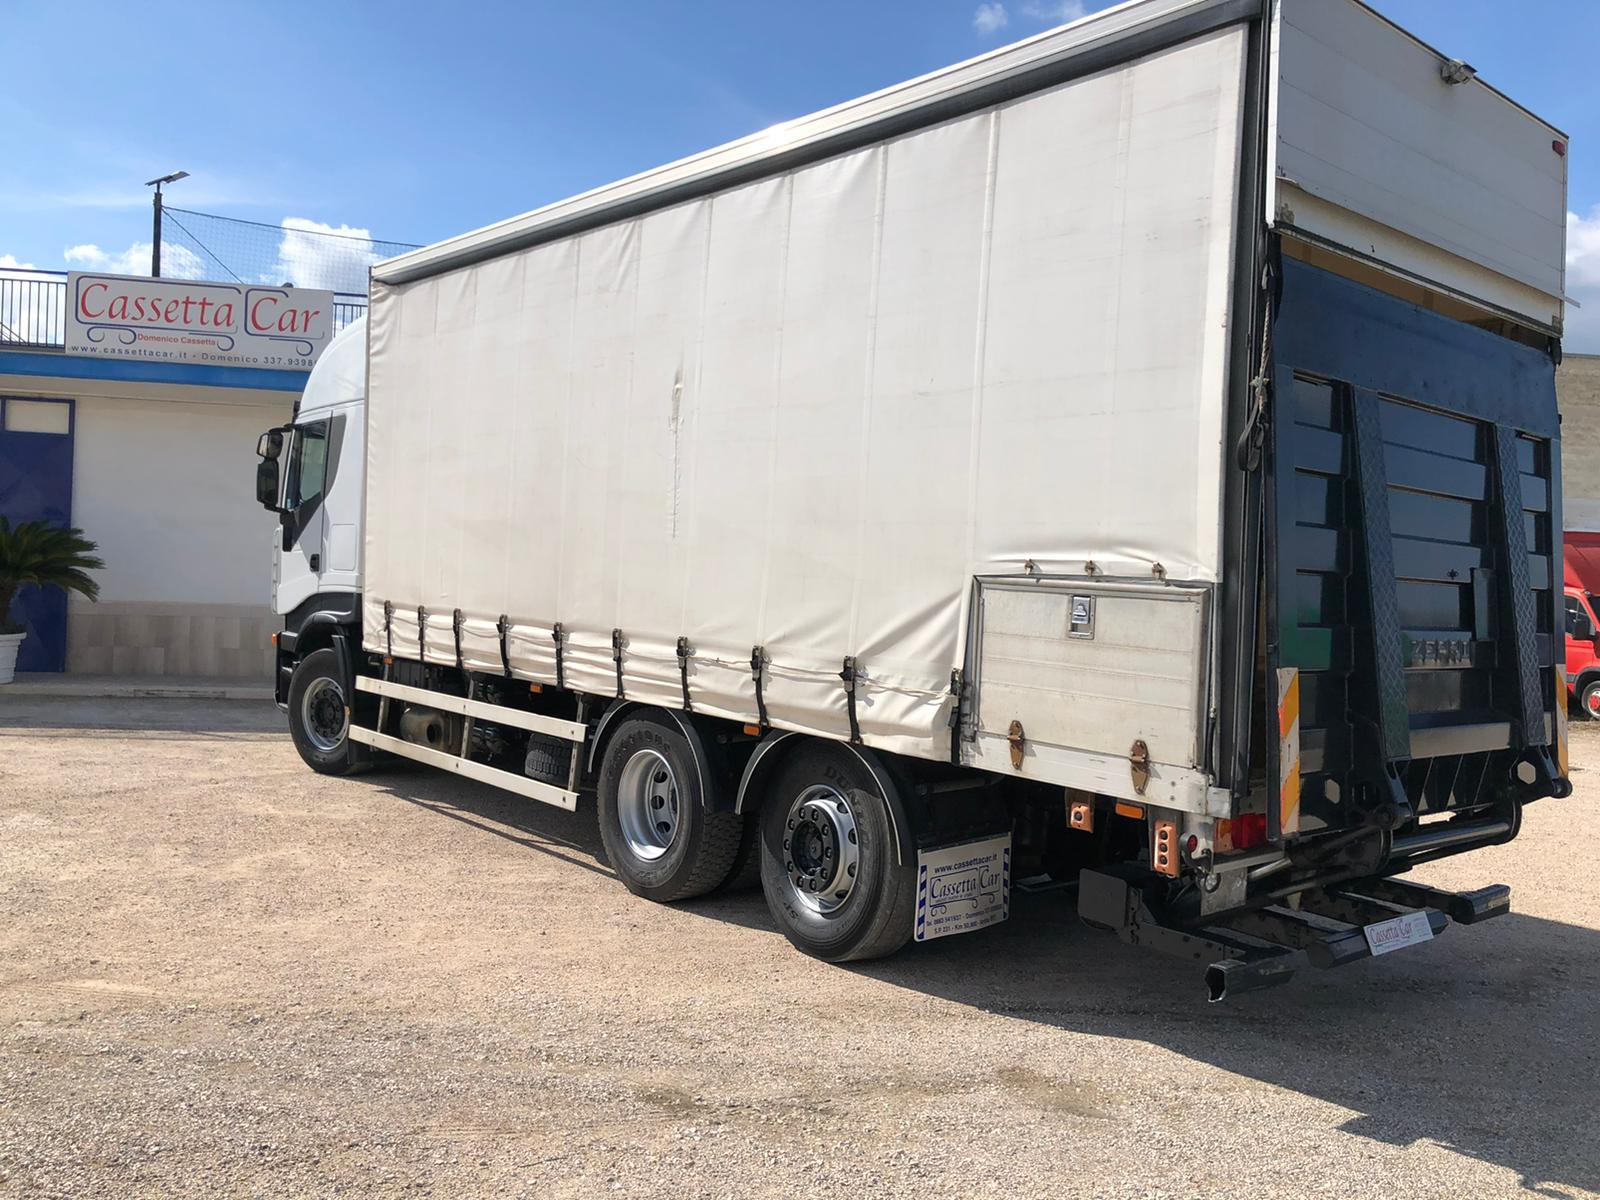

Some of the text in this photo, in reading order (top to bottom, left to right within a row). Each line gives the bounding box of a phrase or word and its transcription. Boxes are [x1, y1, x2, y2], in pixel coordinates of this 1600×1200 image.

[80, 283, 320, 333] Cassetta Car
[137, 333, 216, 346] Domenico Cassetta
[71, 345, 187, 360] www.cassettacar.it
[201, 352, 258, 364] Domenico
[934, 853, 997, 874] www.cassettacar.it
[931, 877, 977, 899] Cassetta
[981, 868, 1000, 889] Car
